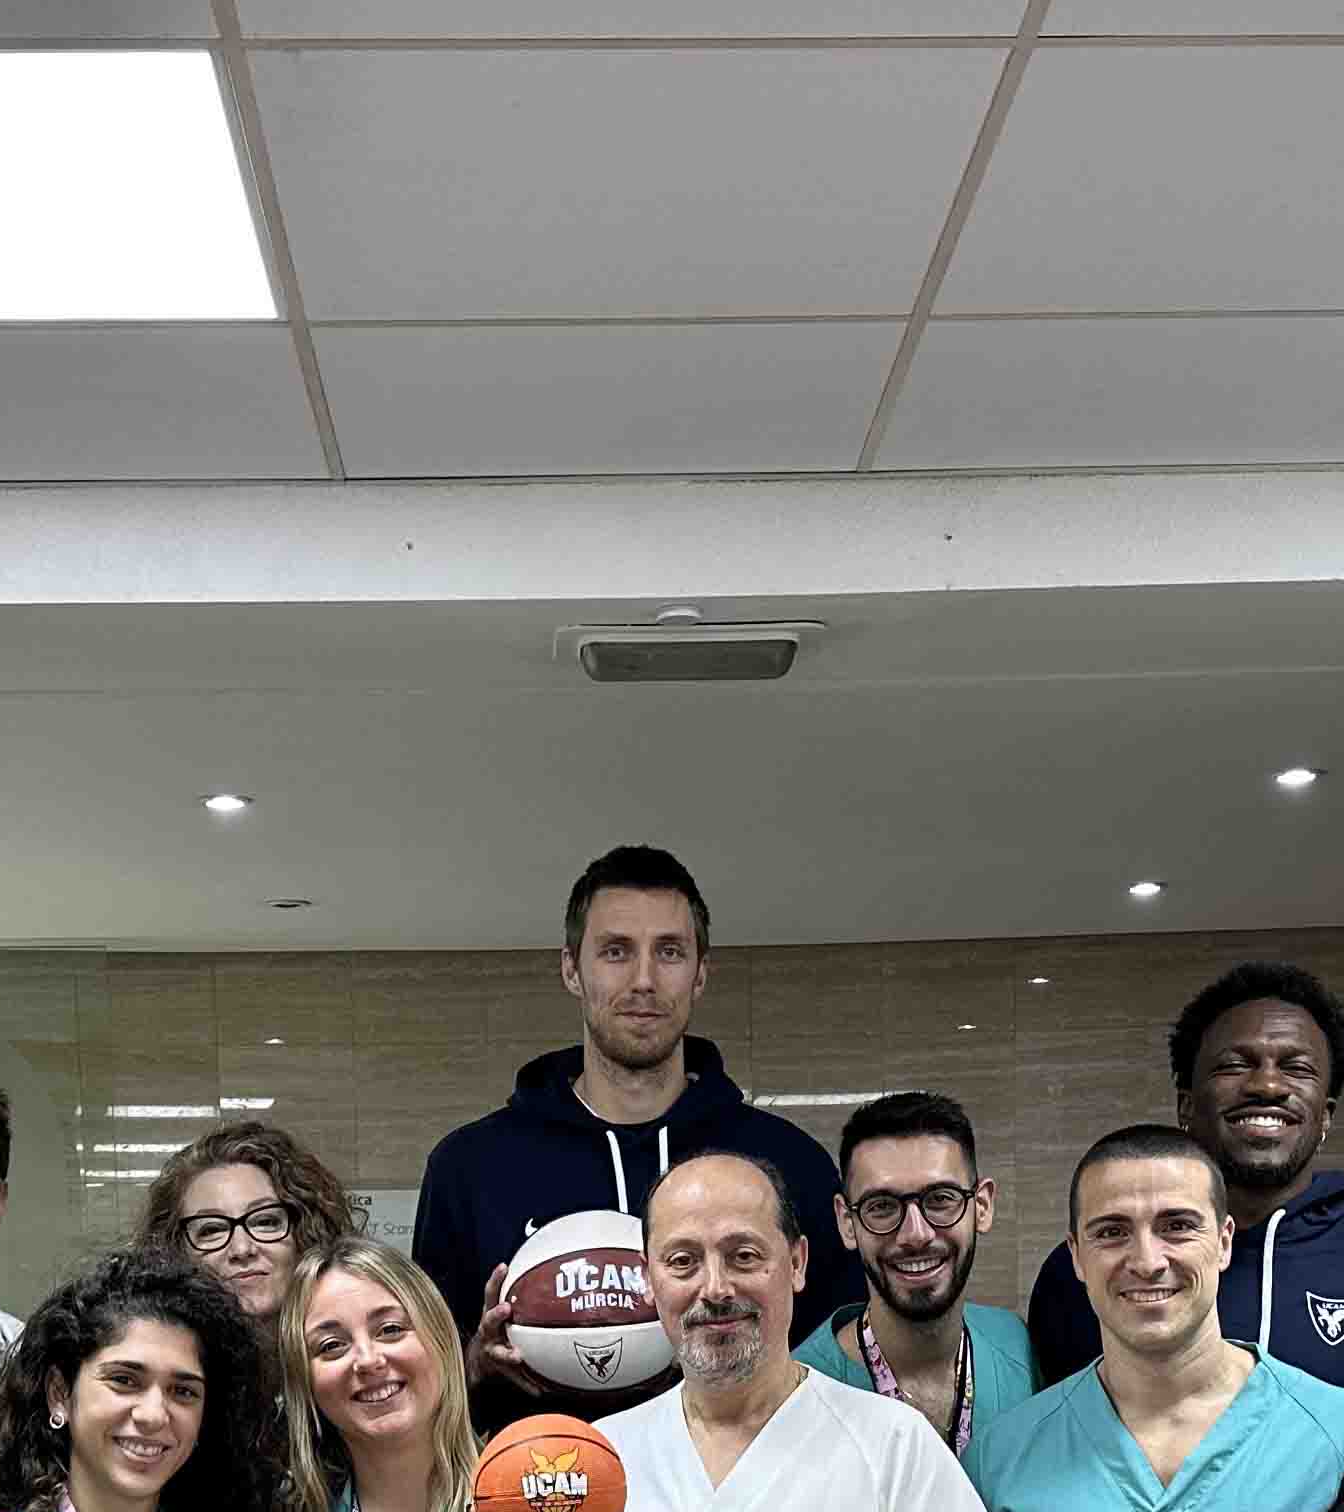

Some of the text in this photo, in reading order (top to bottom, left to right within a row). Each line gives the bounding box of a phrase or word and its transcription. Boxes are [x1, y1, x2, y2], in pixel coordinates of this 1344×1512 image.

[555, 1259, 645, 1298] UCAM
[570, 1291, 635, 1312] MURCIA
[521, 1471, 589, 1499] UCAM
